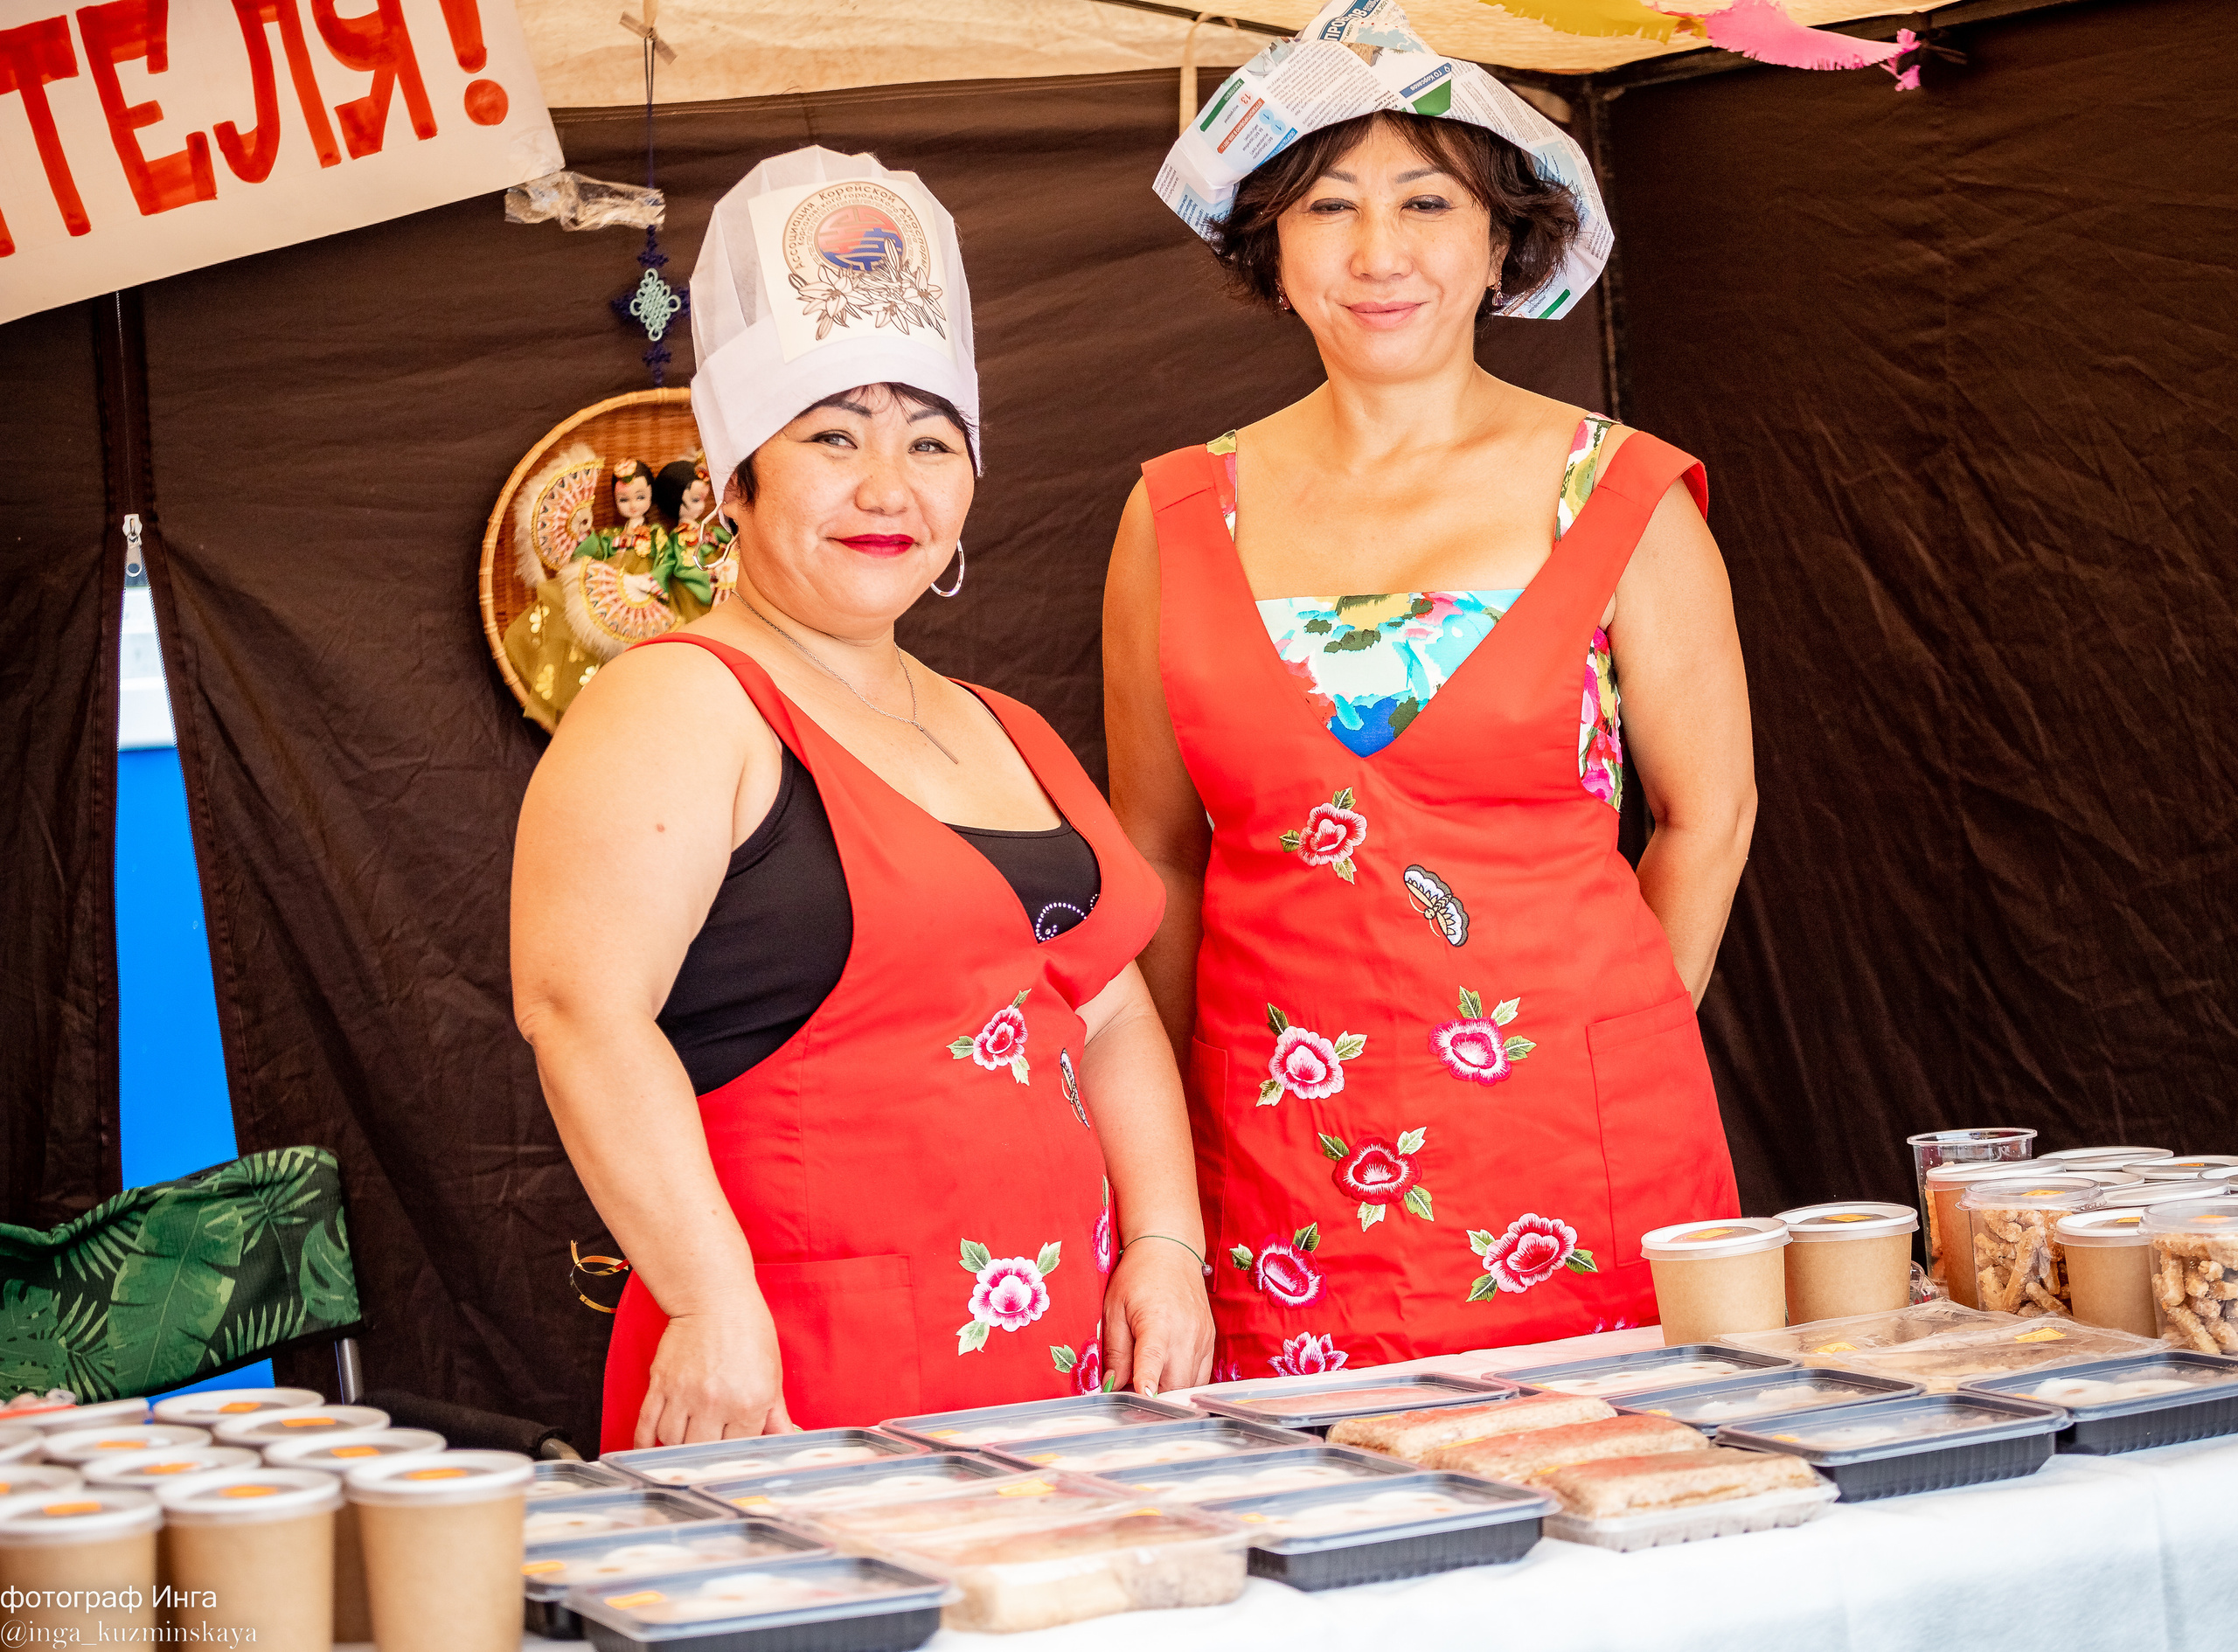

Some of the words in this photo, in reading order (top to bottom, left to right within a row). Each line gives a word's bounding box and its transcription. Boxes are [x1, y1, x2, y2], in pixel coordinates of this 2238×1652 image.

[1433, 69, 1442, 78] ГО
[1241, 93, 1251, 105] 13
[0, 0, 509, 257] ТЕЛЯ!
[789, 202, 816, 270] Ассоциация
[818, 183, 896, 203] Корейской
